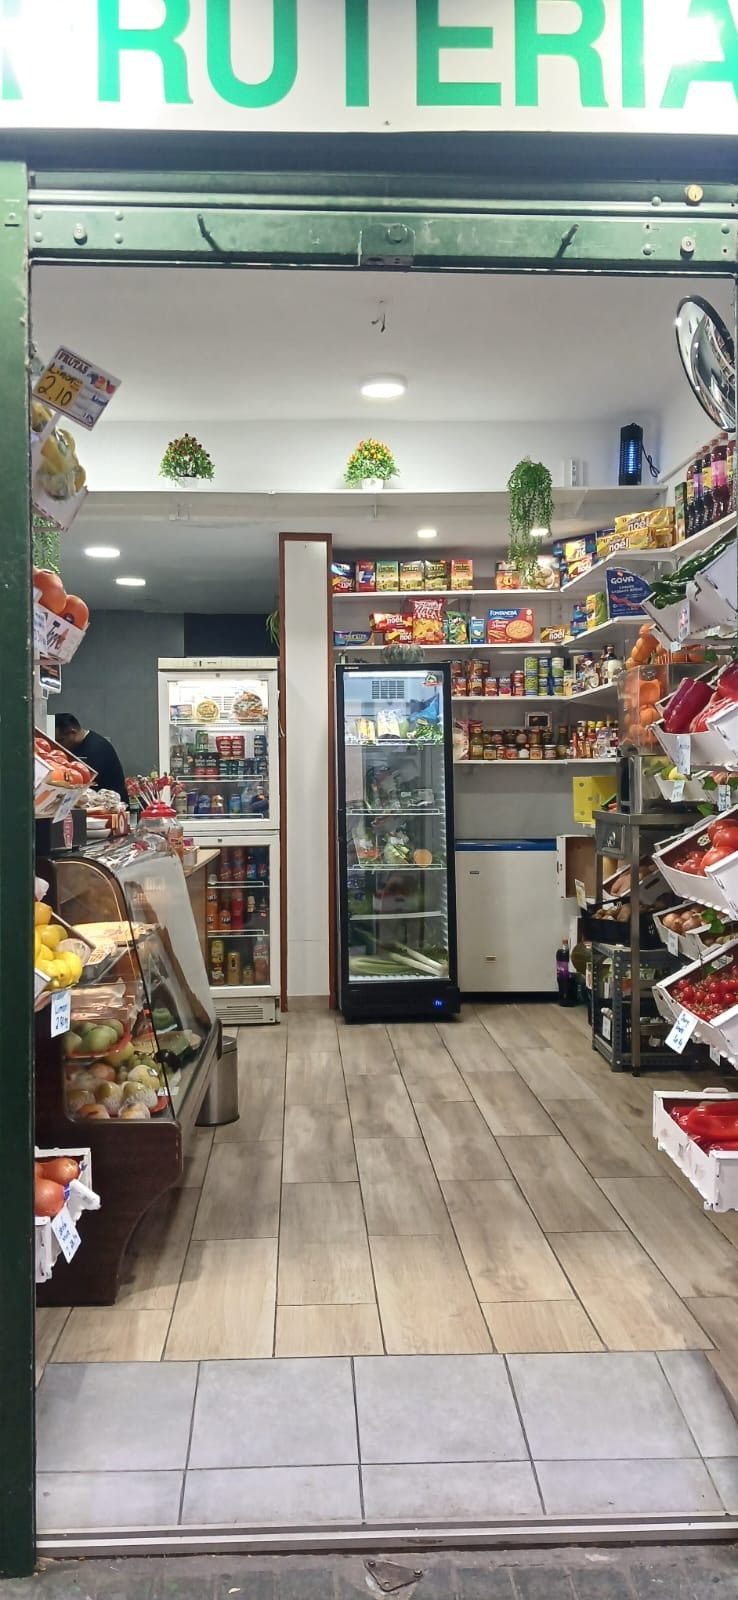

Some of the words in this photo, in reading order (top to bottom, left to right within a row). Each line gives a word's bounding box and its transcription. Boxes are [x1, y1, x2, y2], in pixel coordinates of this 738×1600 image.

[57, 350, 89, 375] FRUTAS
[37, 375, 73, 407] 2.10
[610, 576, 635, 585] GOYA
